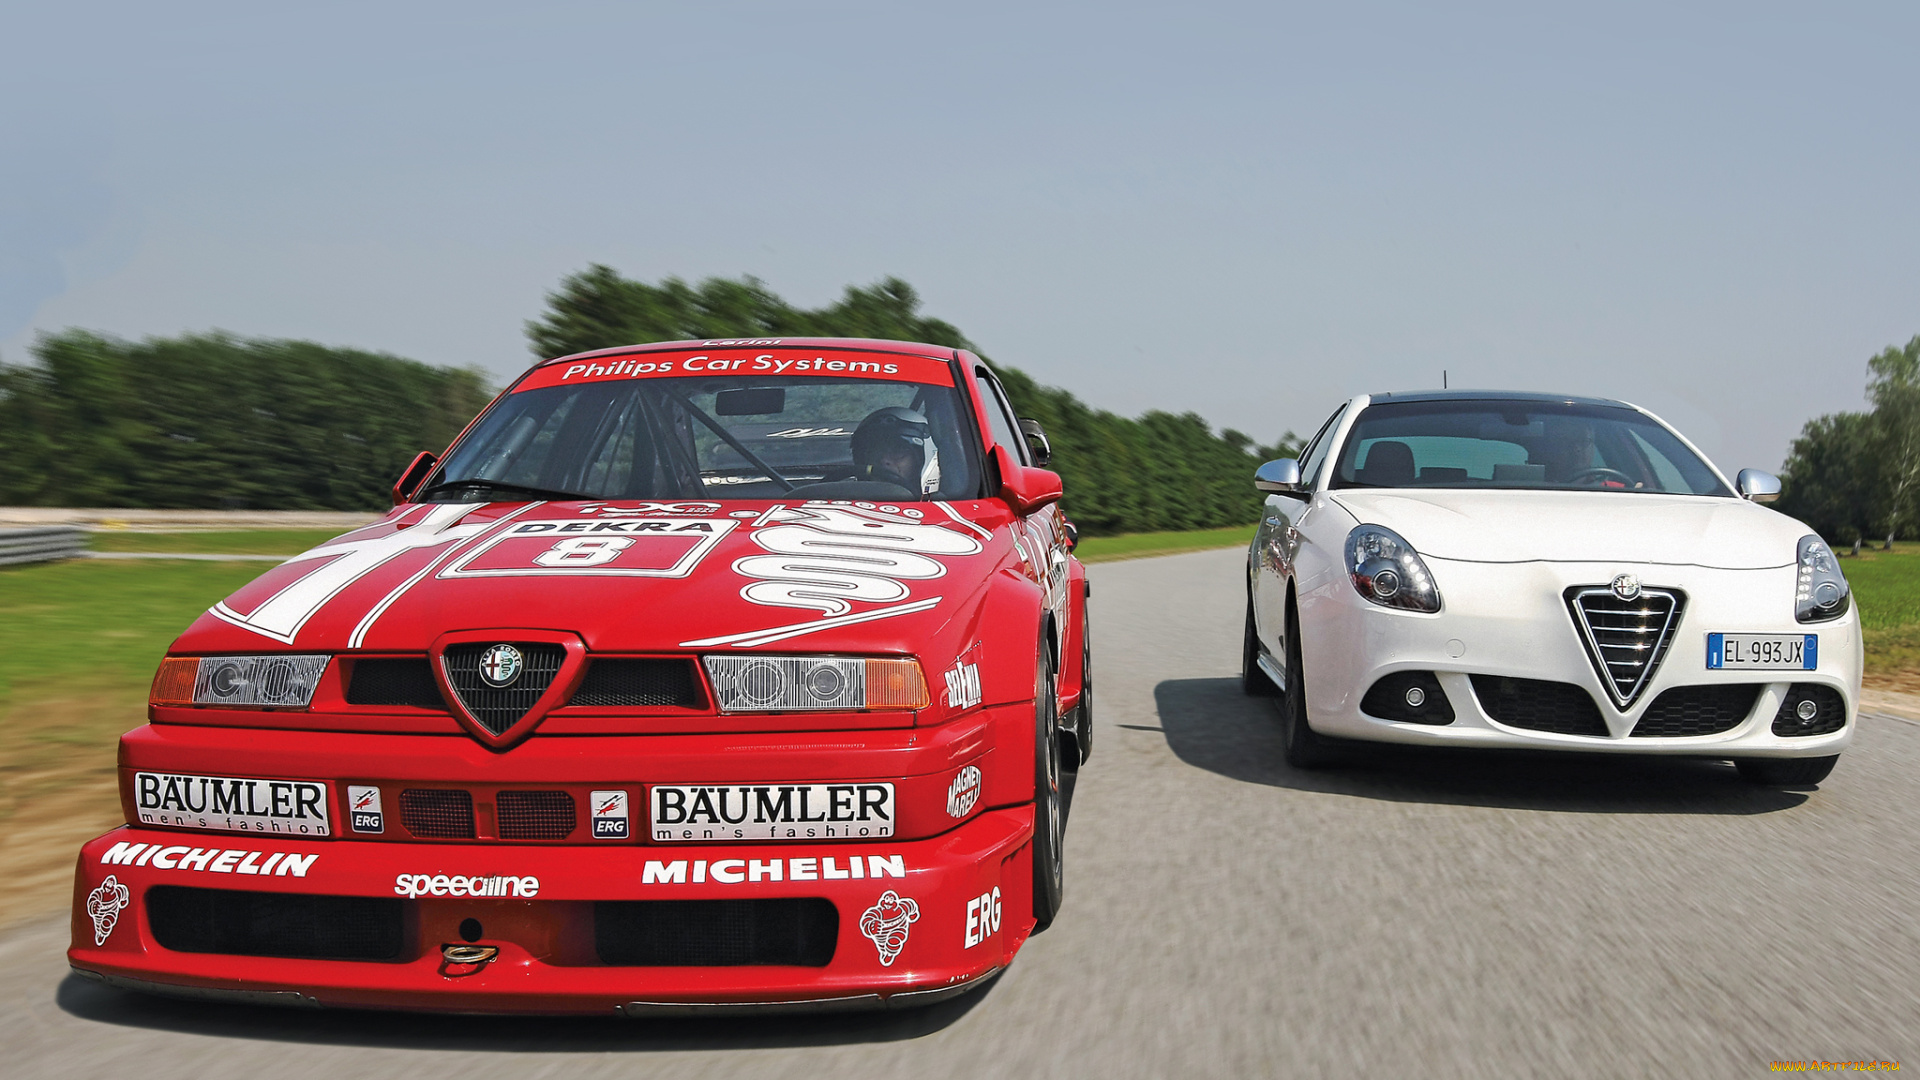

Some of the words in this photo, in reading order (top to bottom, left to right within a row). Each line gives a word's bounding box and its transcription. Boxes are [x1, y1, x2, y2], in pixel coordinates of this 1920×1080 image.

[562, 358, 673, 380] Philips
[682, 355, 746, 372] Car
[751, 354, 899, 375] Systems
[514, 521, 714, 533] DEKRA
[531, 535, 637, 567] 8
[138, 774, 324, 820] BÄUMLER
[656, 785, 890, 824] BÄUMLER
[142, 812, 207, 828] men's
[225, 817, 326, 835] fashion
[354, 814, 380, 828] ERG
[596, 820, 625, 833] ERG
[656, 826, 743, 839] men's
[769, 825, 889, 838] fashion
[100, 841, 320, 878] MICHELIN
[642, 855, 906, 884] MICHELIN
[964, 886, 1001, 949] ERG
